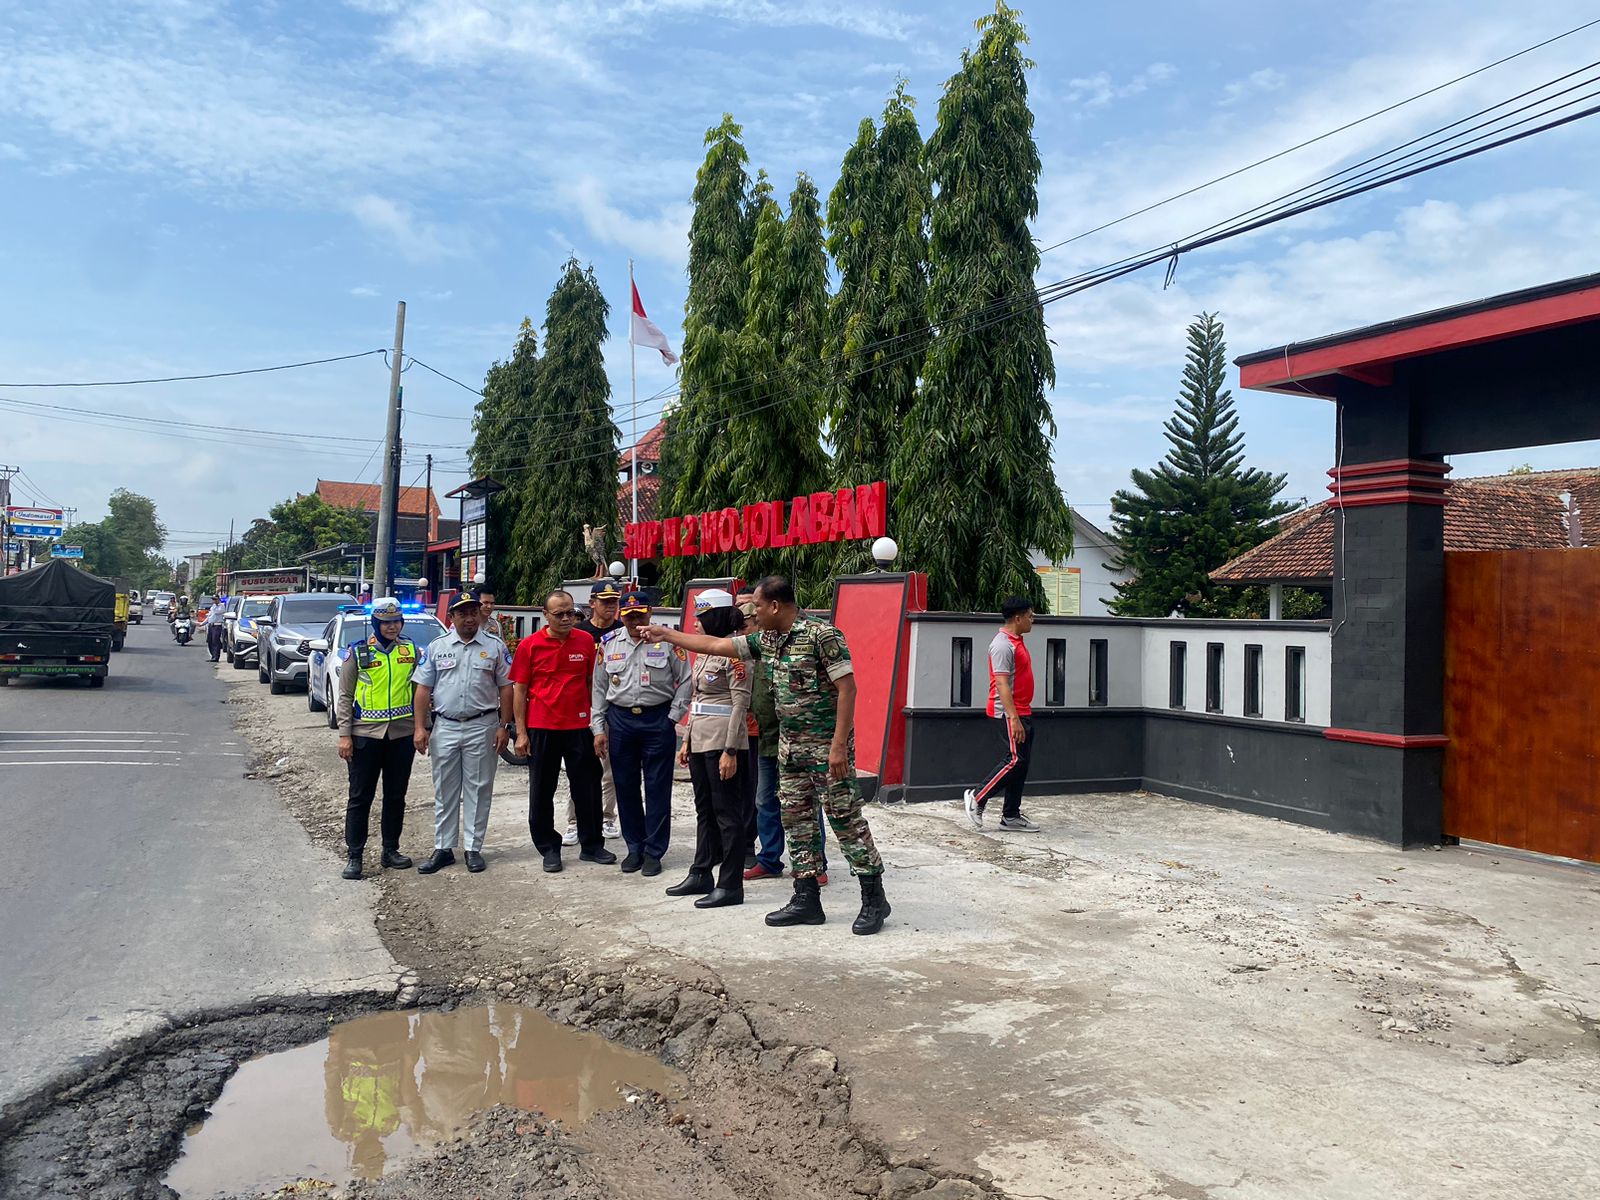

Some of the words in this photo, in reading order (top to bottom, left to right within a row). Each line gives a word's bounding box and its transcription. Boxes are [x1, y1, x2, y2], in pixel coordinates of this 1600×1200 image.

[623, 521, 661, 559] SMP
[663, 517, 682, 557] N
[682, 514, 699, 556] 2
[700, 481, 888, 555] MOJOLABAN
[241, 578, 266, 586] SUSU
[267, 576, 299, 584] SEGAR
